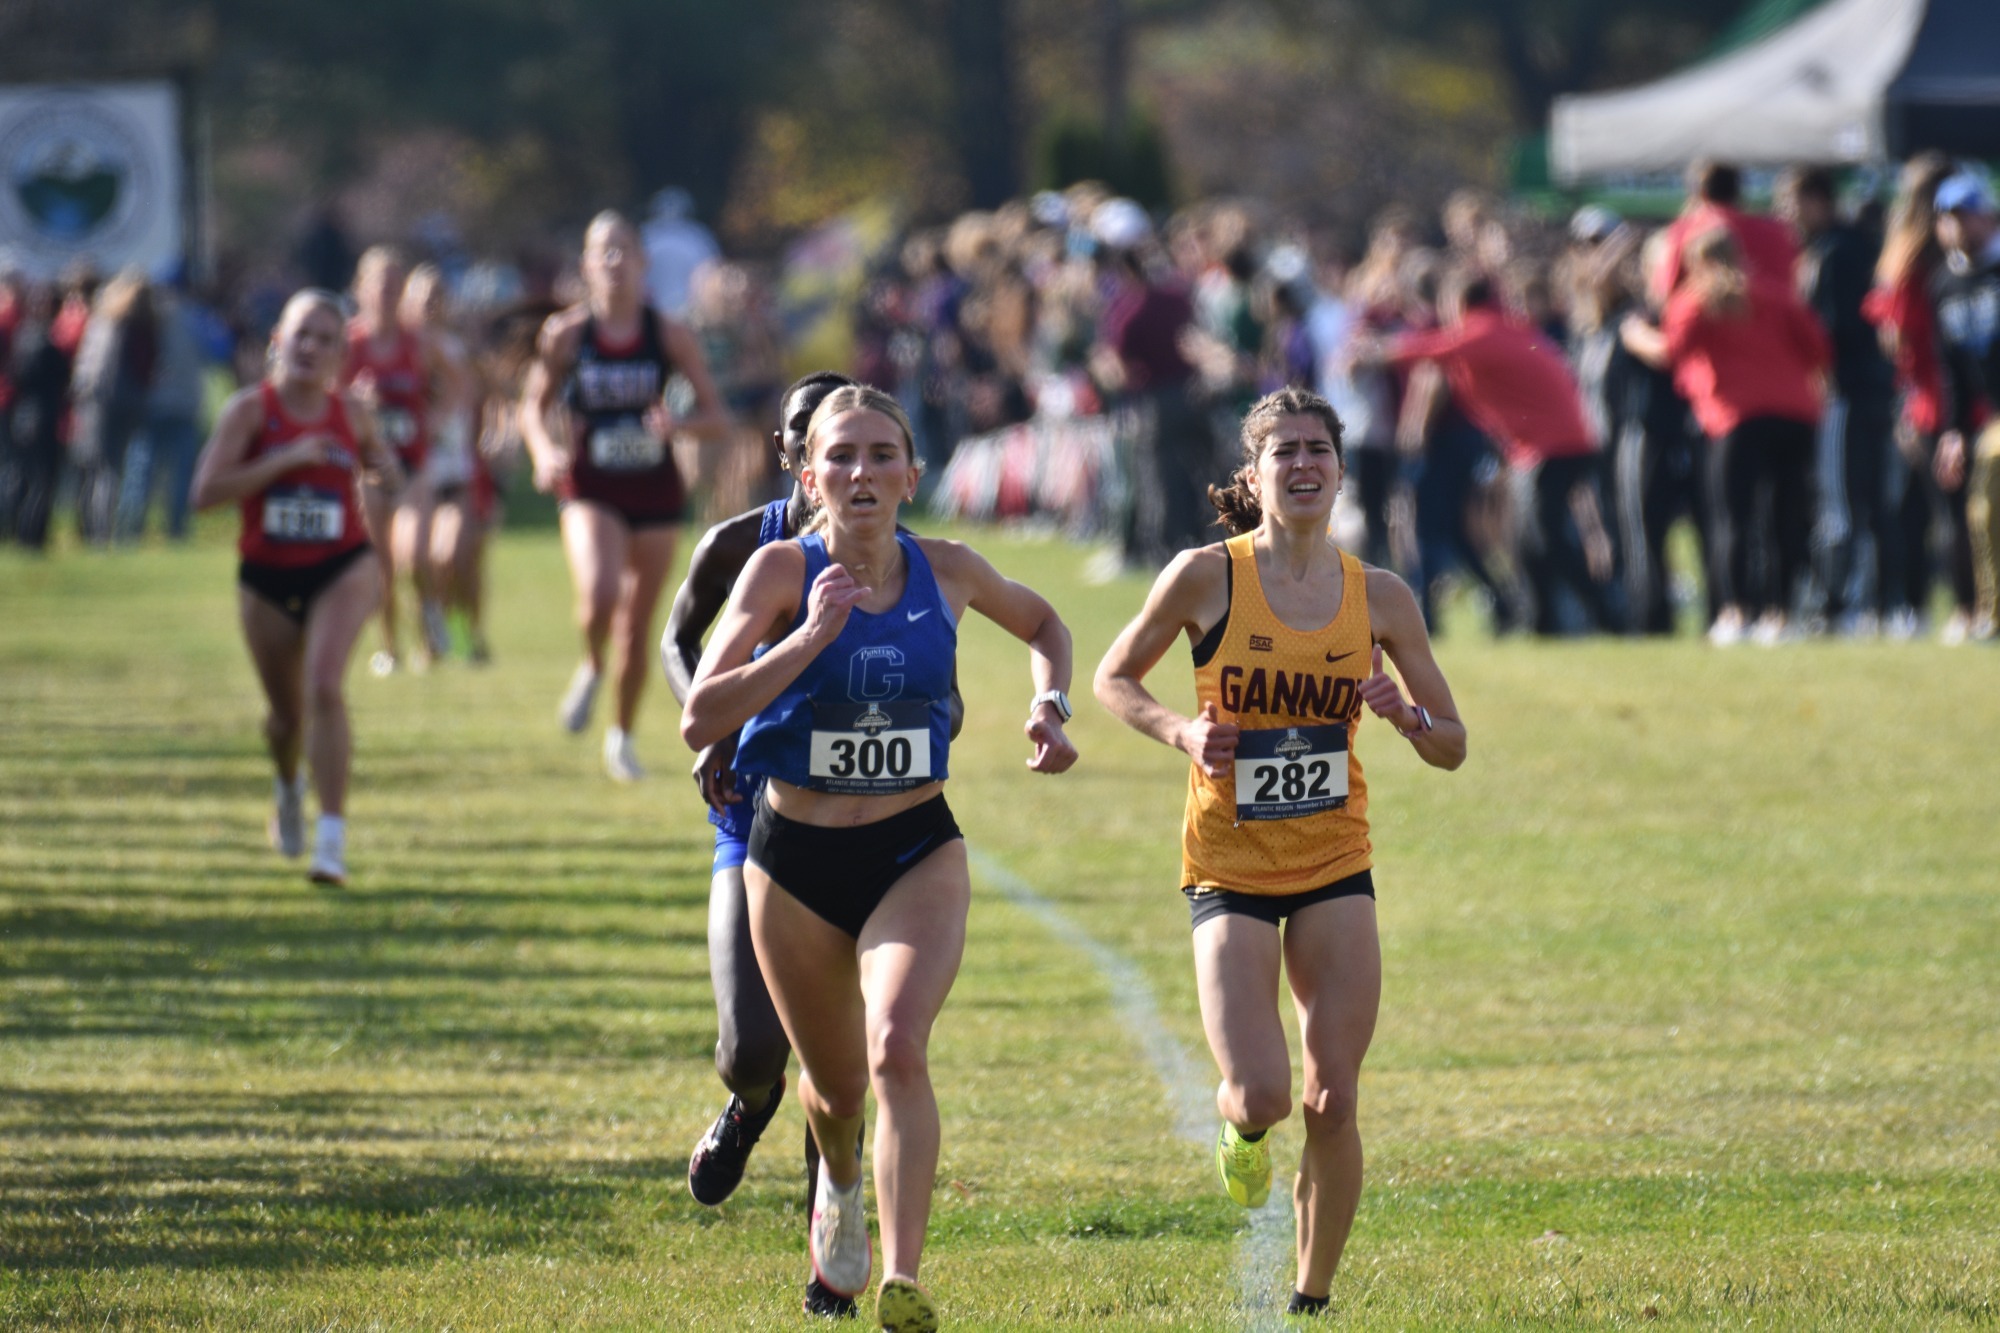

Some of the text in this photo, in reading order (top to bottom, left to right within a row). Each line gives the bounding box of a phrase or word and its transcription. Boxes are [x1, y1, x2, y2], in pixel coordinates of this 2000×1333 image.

[847, 646, 904, 703] G
[829, 737, 912, 778] 300
[1254, 760, 1331, 803] 282
[1252, 804, 1274, 812] ATLANTIC
[1275, 803, 1294, 812] REGION
[1296, 800, 1319, 810] November
